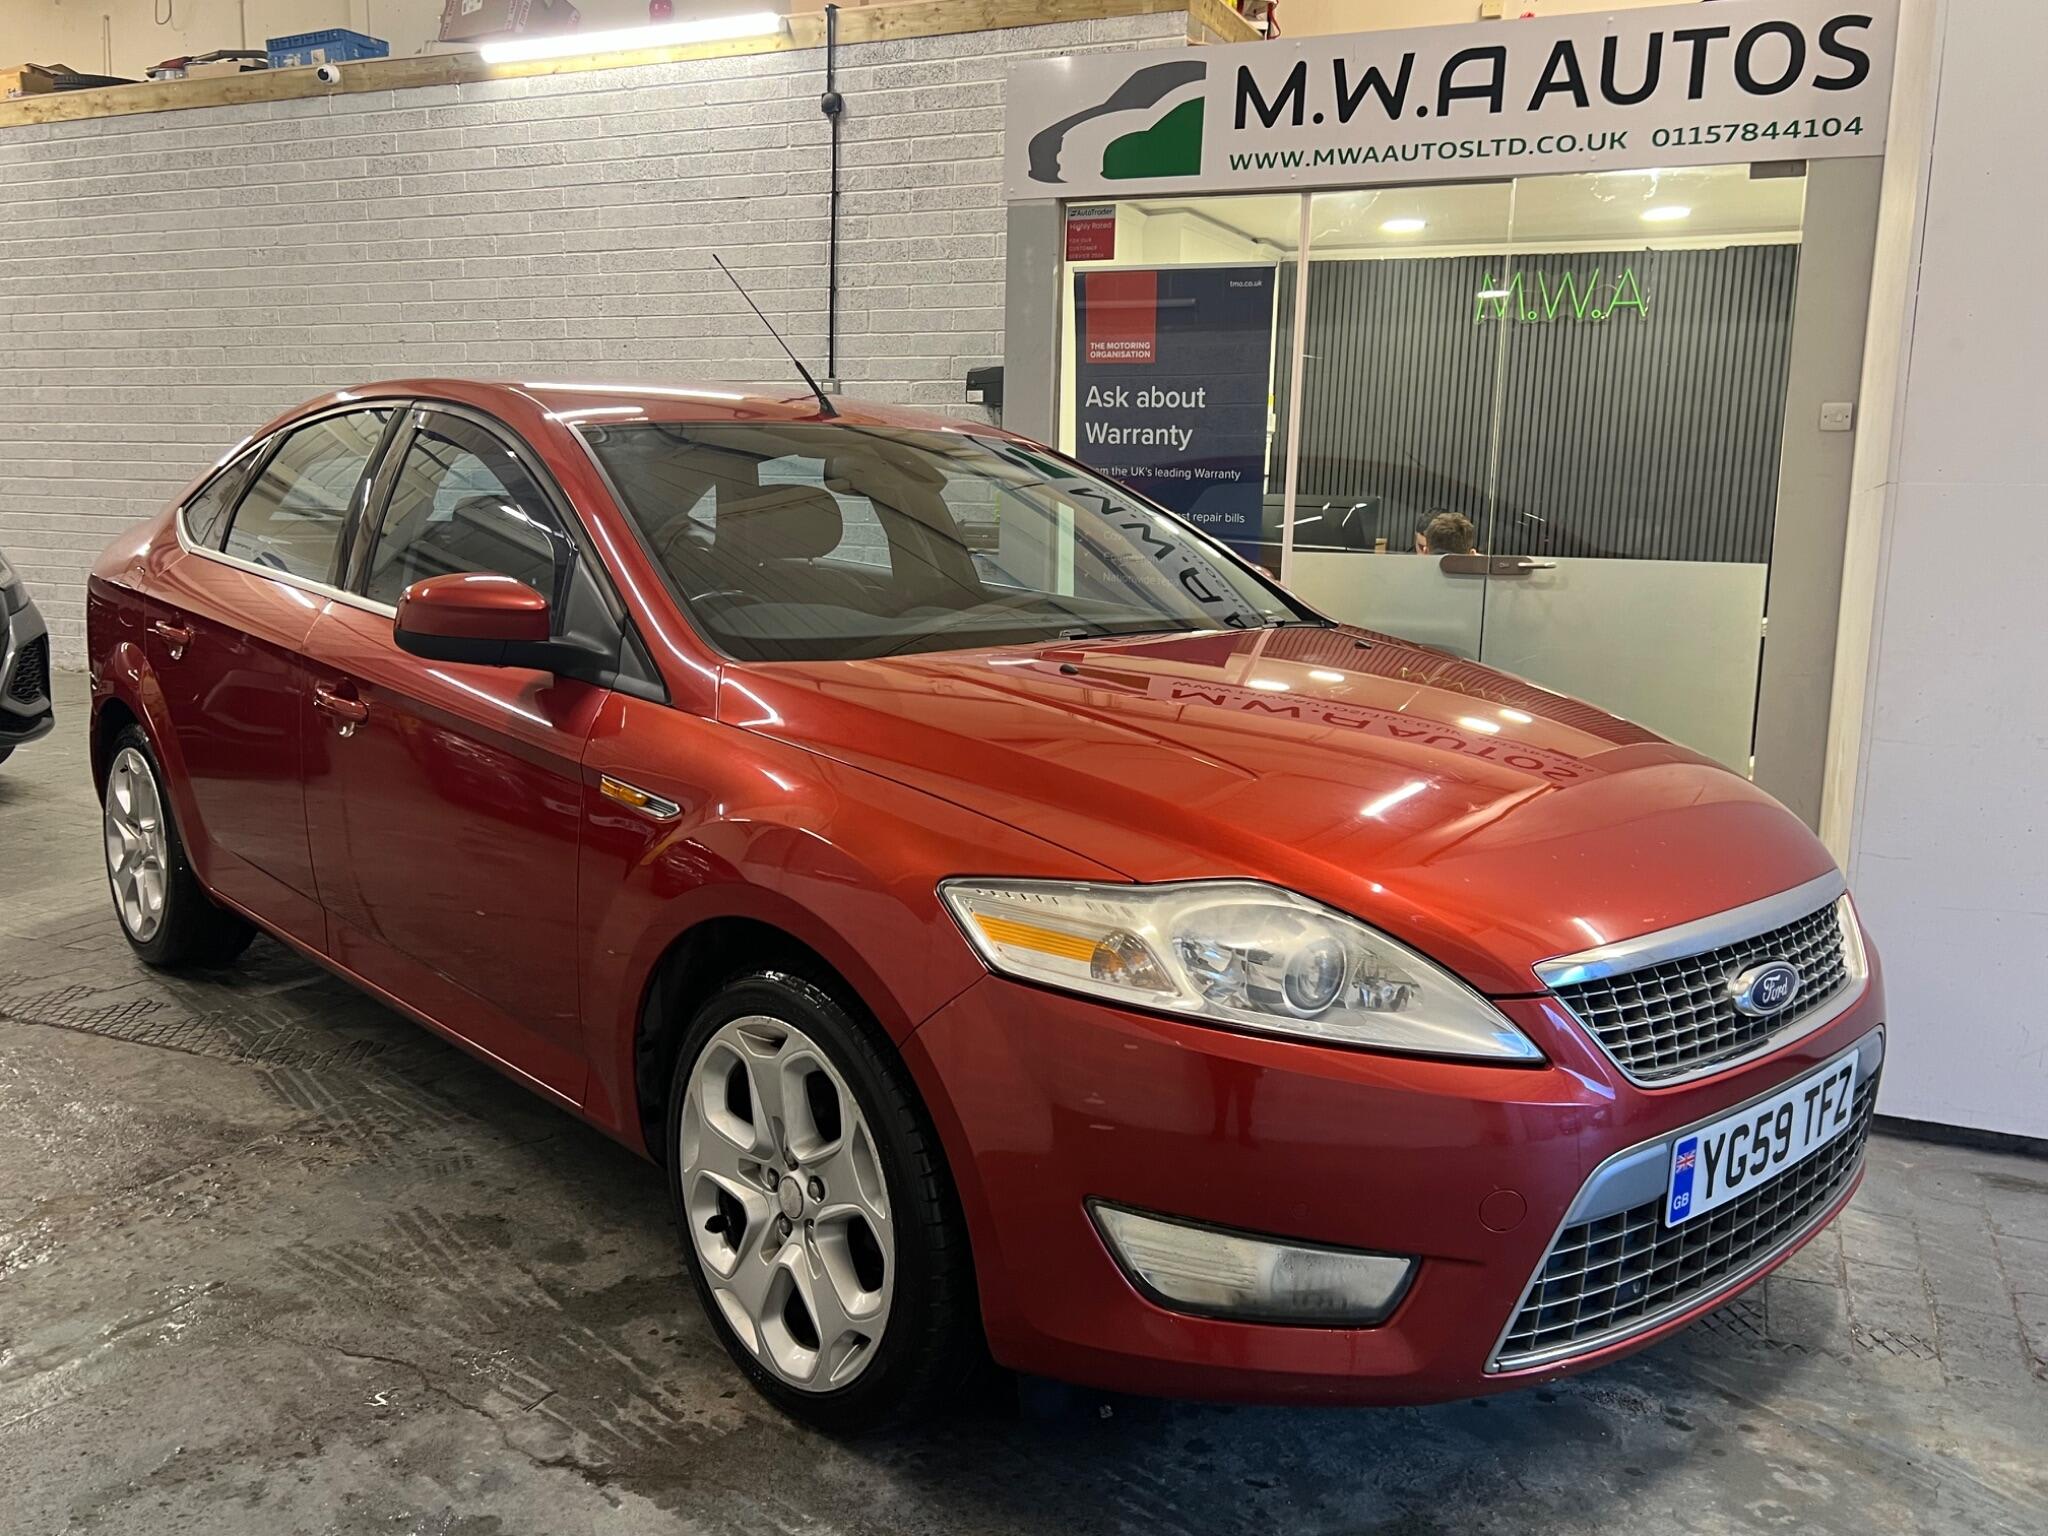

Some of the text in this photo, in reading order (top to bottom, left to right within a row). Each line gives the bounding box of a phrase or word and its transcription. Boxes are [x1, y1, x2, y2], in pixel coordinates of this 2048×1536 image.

[1234, 14, 1873, 130] M.W.A AUTOS
[1229, 116, 1864, 171] WWW.MWAAUTOSLTD.CO.UK 01157844104
[1229, 279, 1262, 288] tmo.co.uk
[1475, 267, 1646, 322] M.W.A
[1090, 341, 1151, 350] THE MOTORING
[1090, 350, 1151, 359] ORGANISATION
[1085, 385, 1206, 409] Ask about
[1085, 422, 1193, 451] Warranty
[1111, 467, 1128, 477] the
[1130, 467, 1152, 477] UK's
[1154, 467, 1192, 481] leading
[1194, 468, 1241, 482] Warranty
[1192, 513, 1222, 524] repair
[1224, 513, 1246, 523] bills
[1762, 975, 1789, 1003] Ford
[1704, 1064, 1853, 1200] YG59 TFZ
[1673, 1193, 1690, 1210] GB
